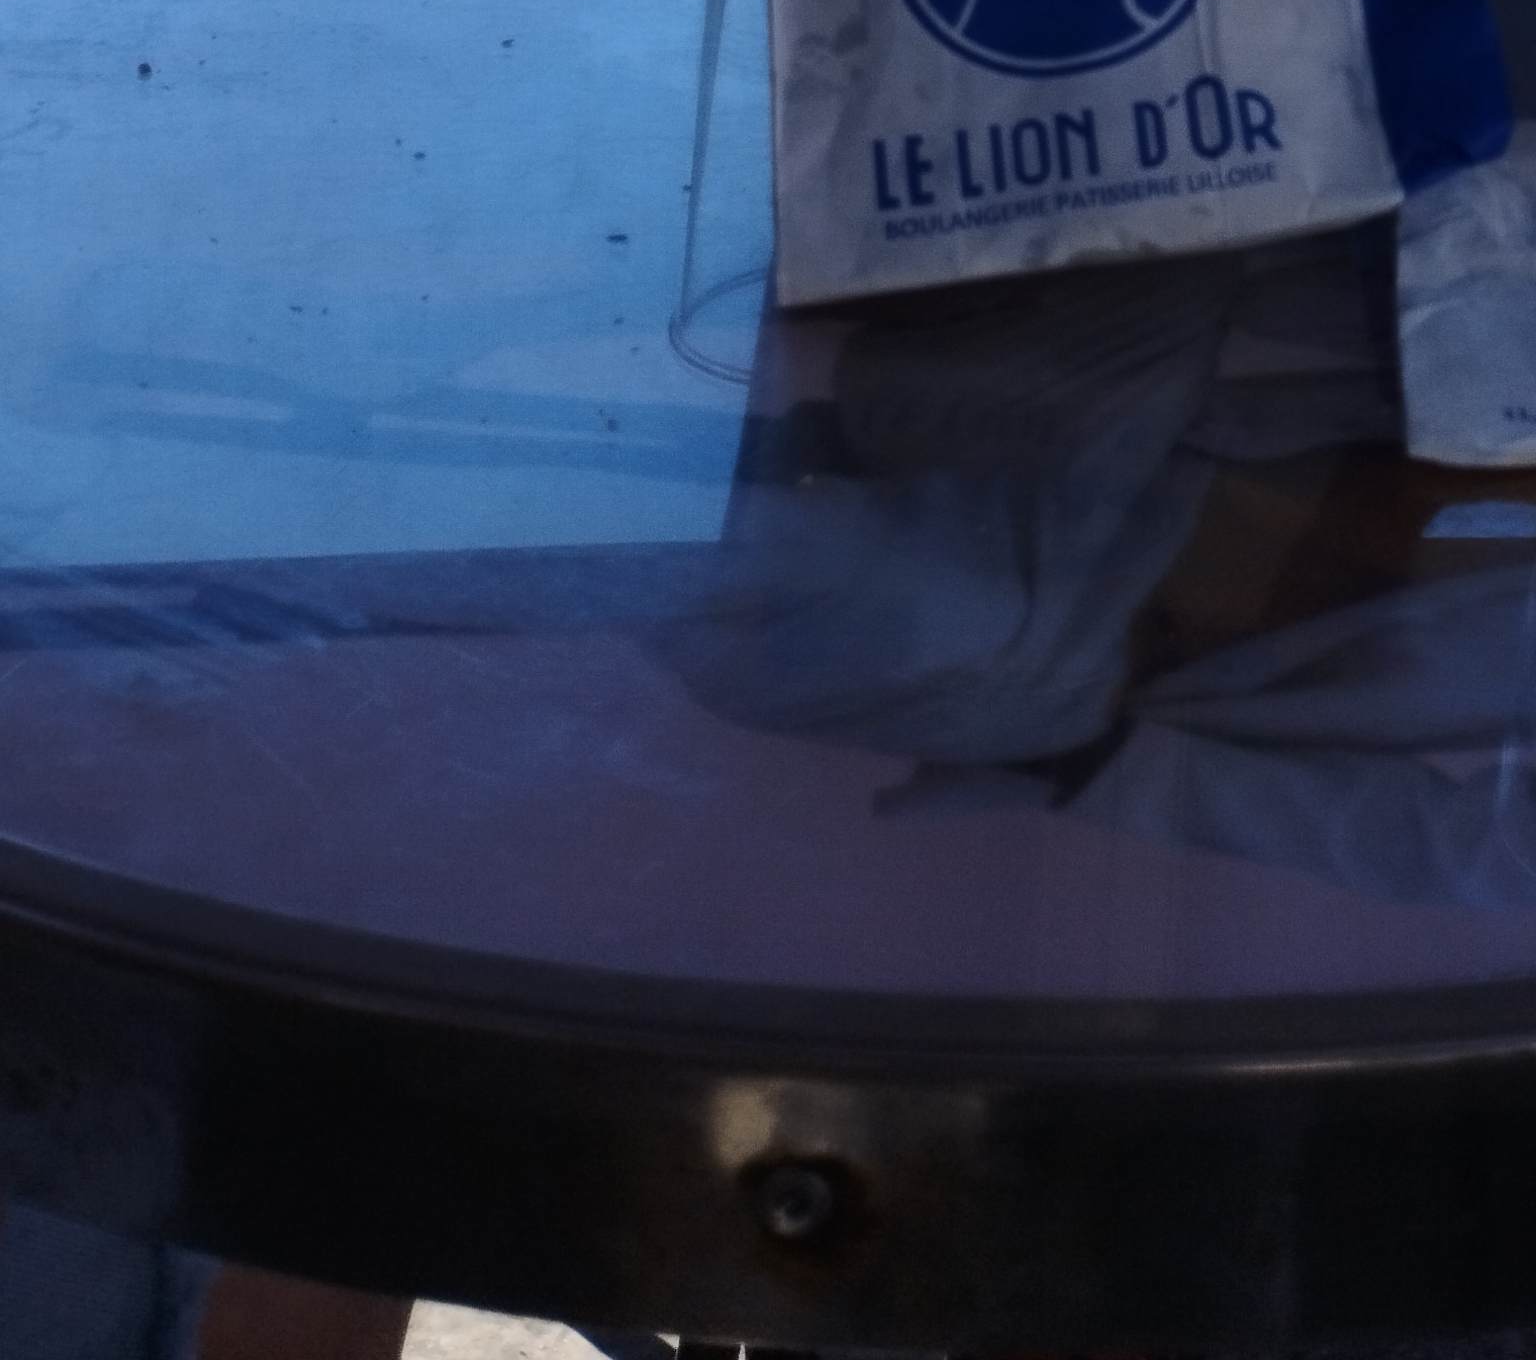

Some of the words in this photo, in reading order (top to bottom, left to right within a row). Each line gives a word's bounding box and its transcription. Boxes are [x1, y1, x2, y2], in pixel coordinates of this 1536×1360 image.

[871, 134, 935, 211] LE
[955, 108, 1101, 198] LION
[884, 196, 1049, 241] BOULANGERIE
[1054, 179, 1180, 212] PATISSERIE
[1186, 162, 1278, 193] LILLOISE
